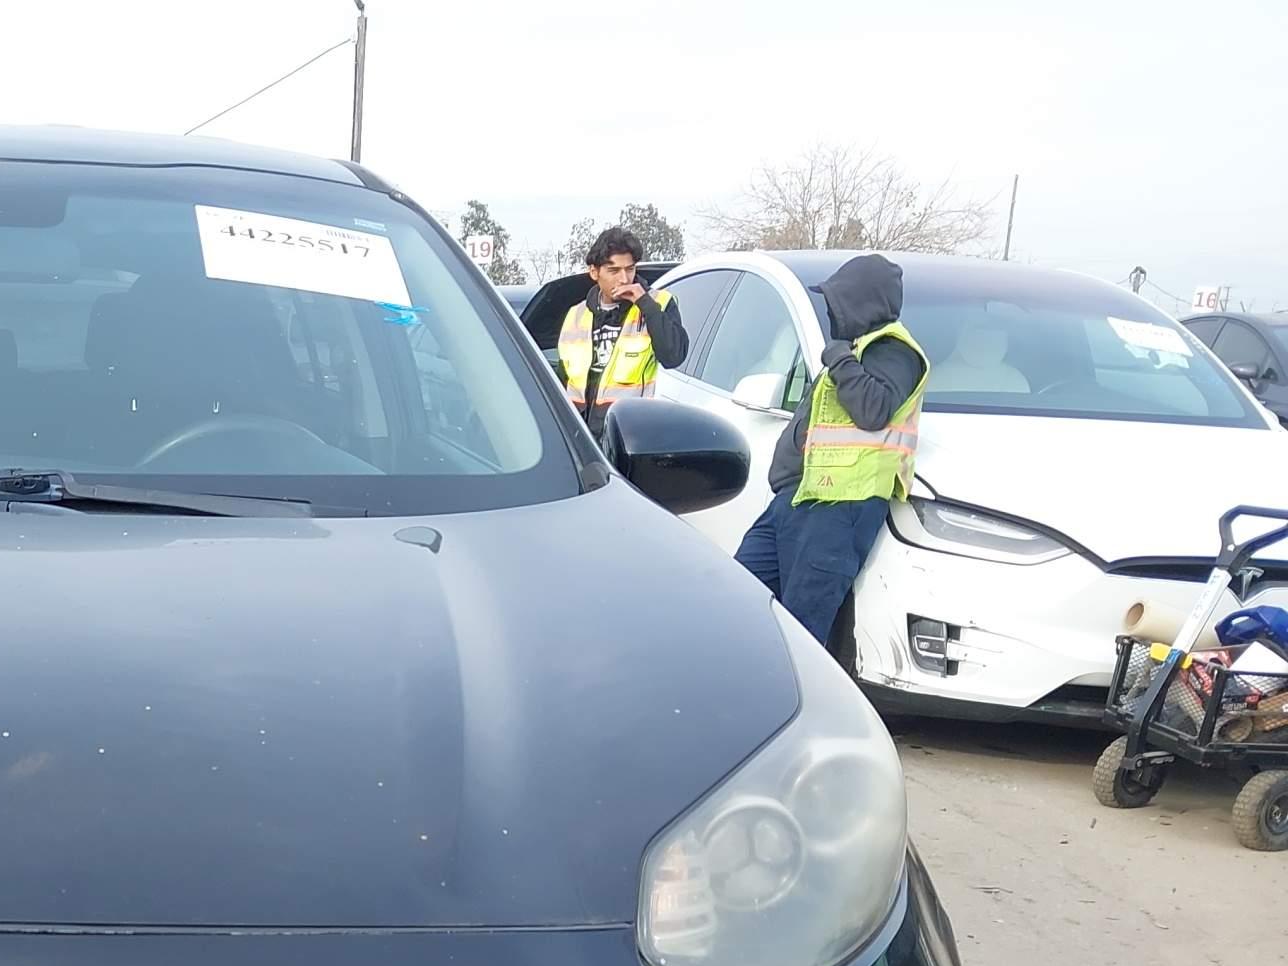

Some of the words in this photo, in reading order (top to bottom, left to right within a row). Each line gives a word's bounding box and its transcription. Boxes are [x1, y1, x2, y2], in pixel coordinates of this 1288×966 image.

[220, 225, 371, 258] 44225517
[468, 241, 491, 258] 19
[1194, 291, 1217, 308] 16
